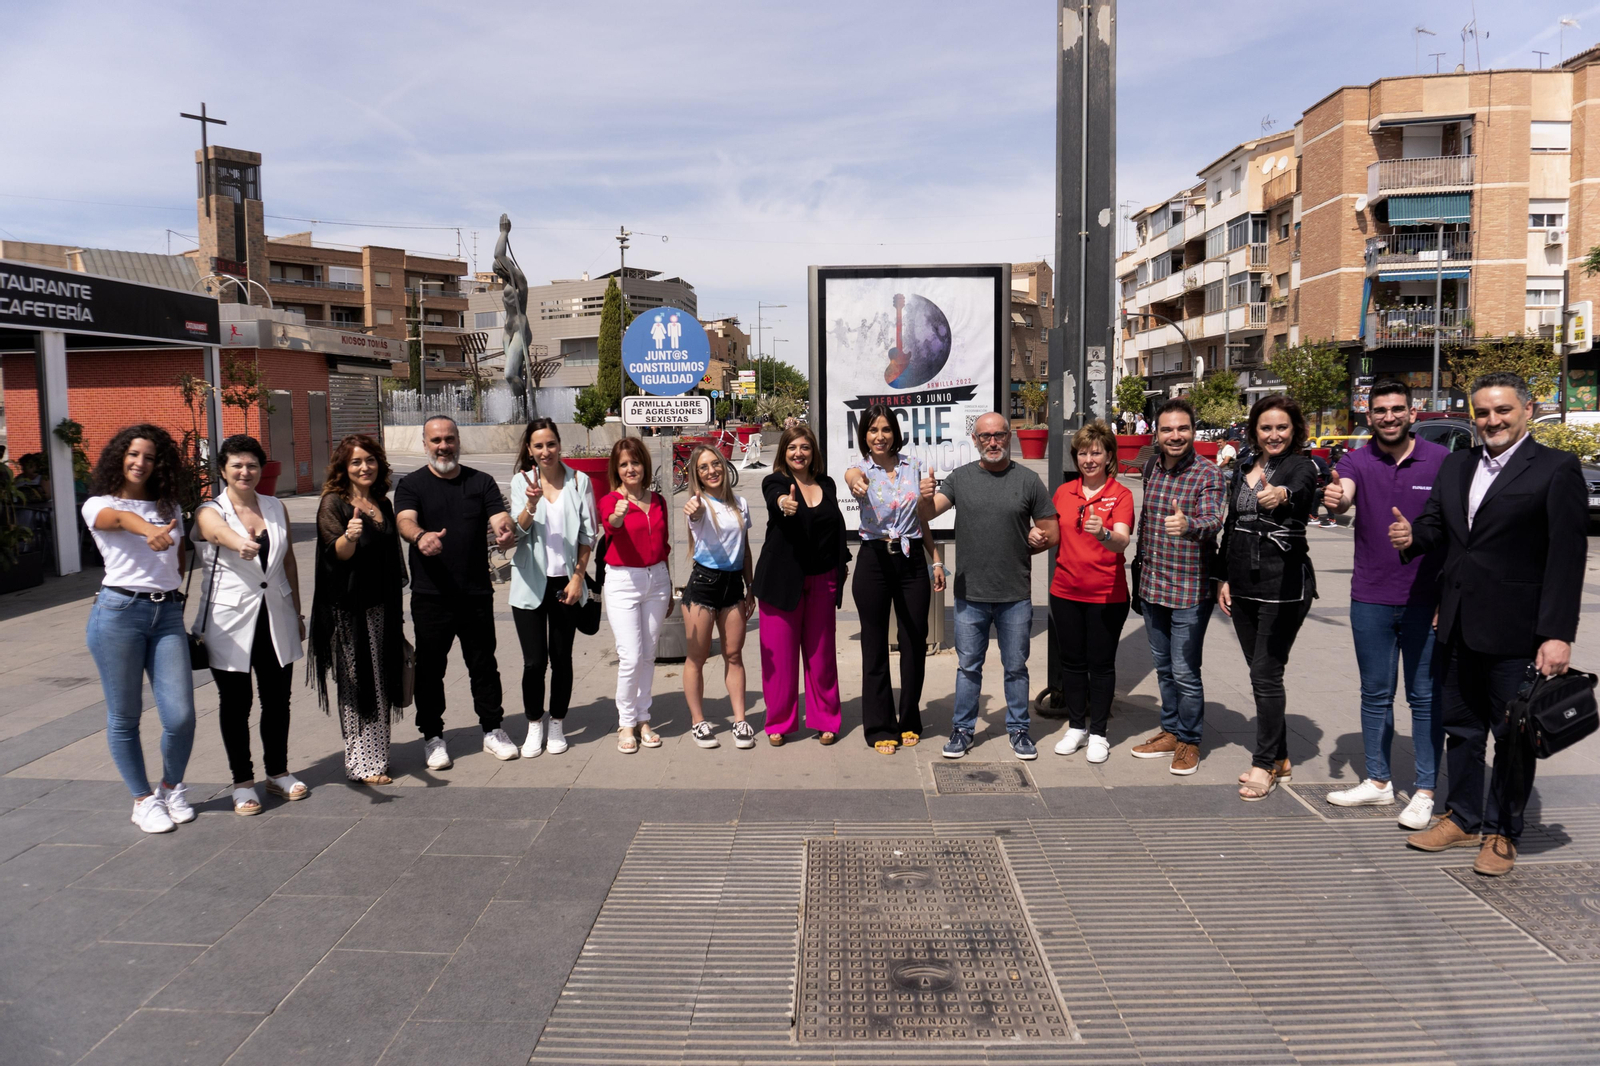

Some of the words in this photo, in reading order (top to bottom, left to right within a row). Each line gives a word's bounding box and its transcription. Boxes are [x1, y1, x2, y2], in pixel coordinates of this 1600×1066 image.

[0, 272, 92, 300] TAURANTE
[0, 297, 94, 323] CAFETERÍA
[341, 335, 366, 346] KIOSCO
[367, 339, 388, 349] TOMÁS
[644, 350, 689, 361] JUNT@S
[629, 361, 705, 373] CONSTRUIMOS
[641, 373, 694, 385] IGUALDAD
[926, 380, 954, 389] ARMILLA
[869, 395, 912, 406] VIERNES
[916, 394, 922, 403] 3
[926, 392, 952, 403] JUNIO
[847, 407, 952, 449] NCHE
[895, 1017, 969, 1025] GRANADA
